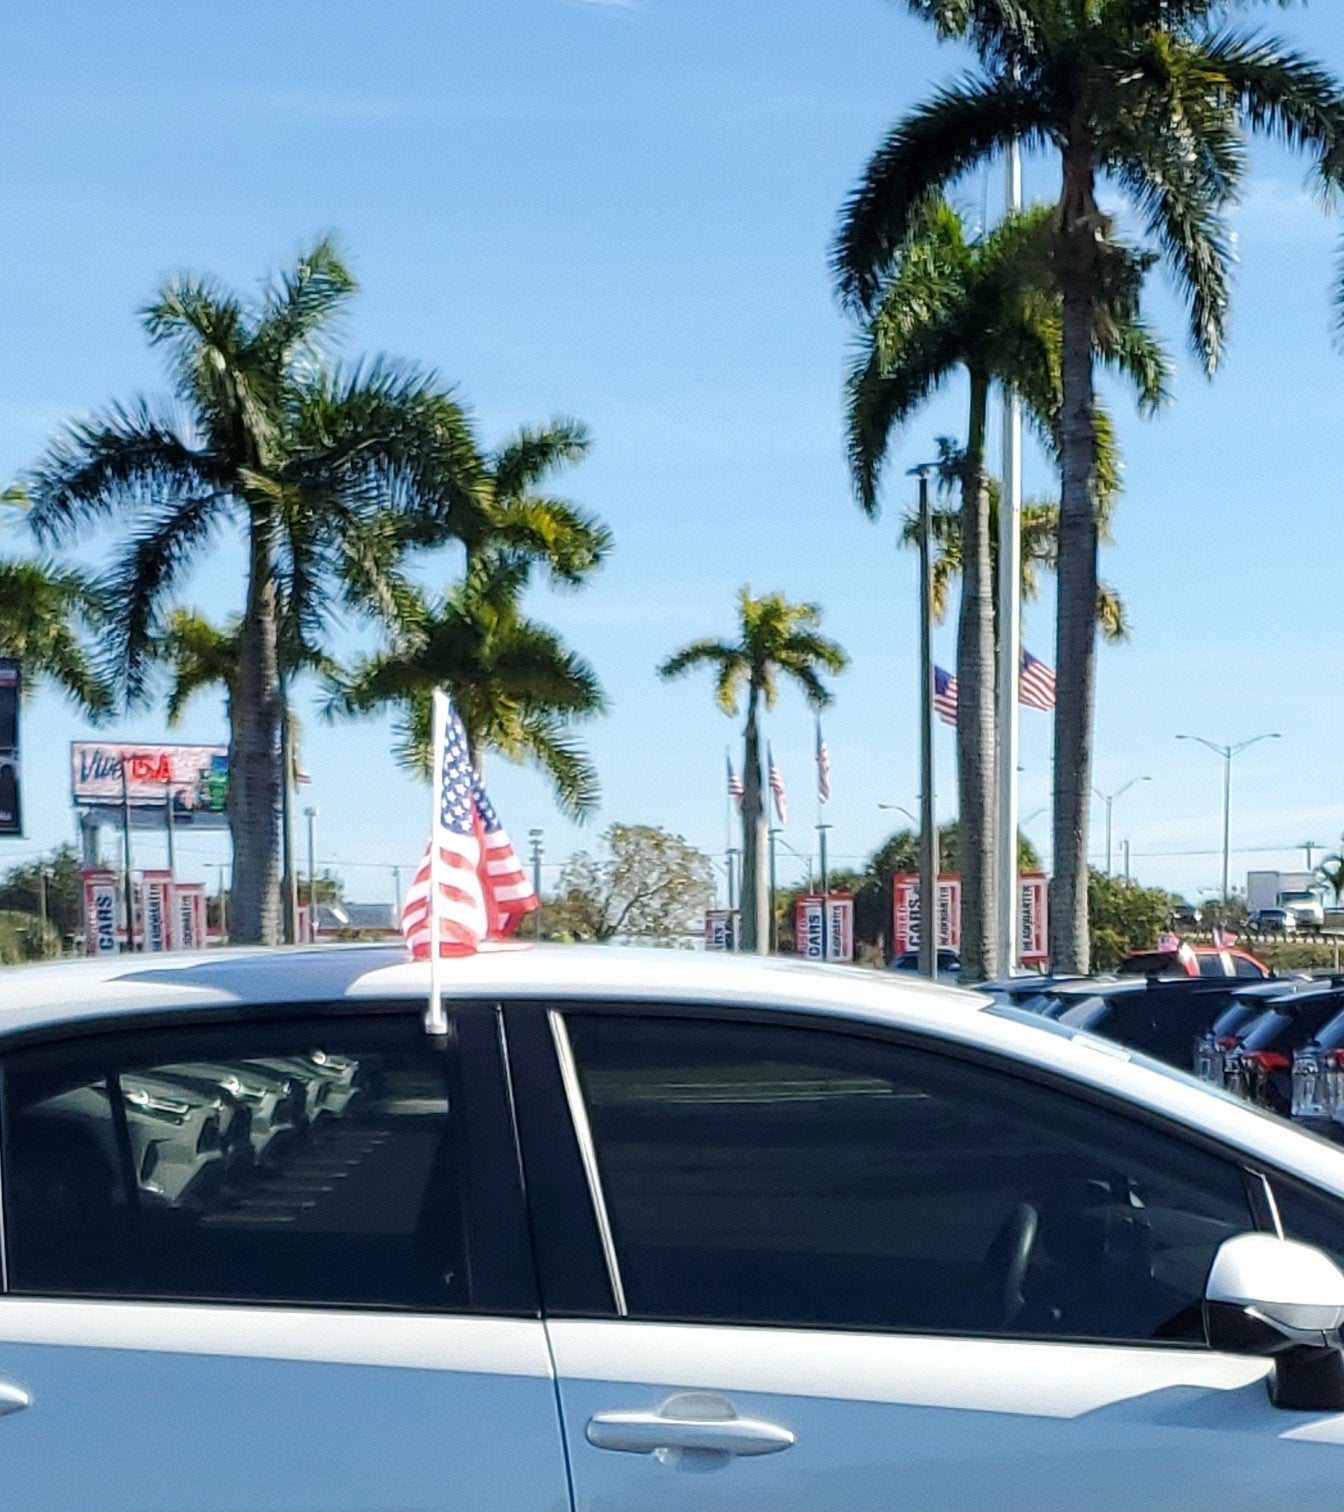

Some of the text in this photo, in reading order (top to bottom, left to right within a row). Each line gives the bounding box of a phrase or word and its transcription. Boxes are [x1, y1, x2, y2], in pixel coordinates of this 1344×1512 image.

[96, 896, 114, 950] CARS
[808, 915, 821, 956] CARS
[908, 899, 922, 947] CARS
